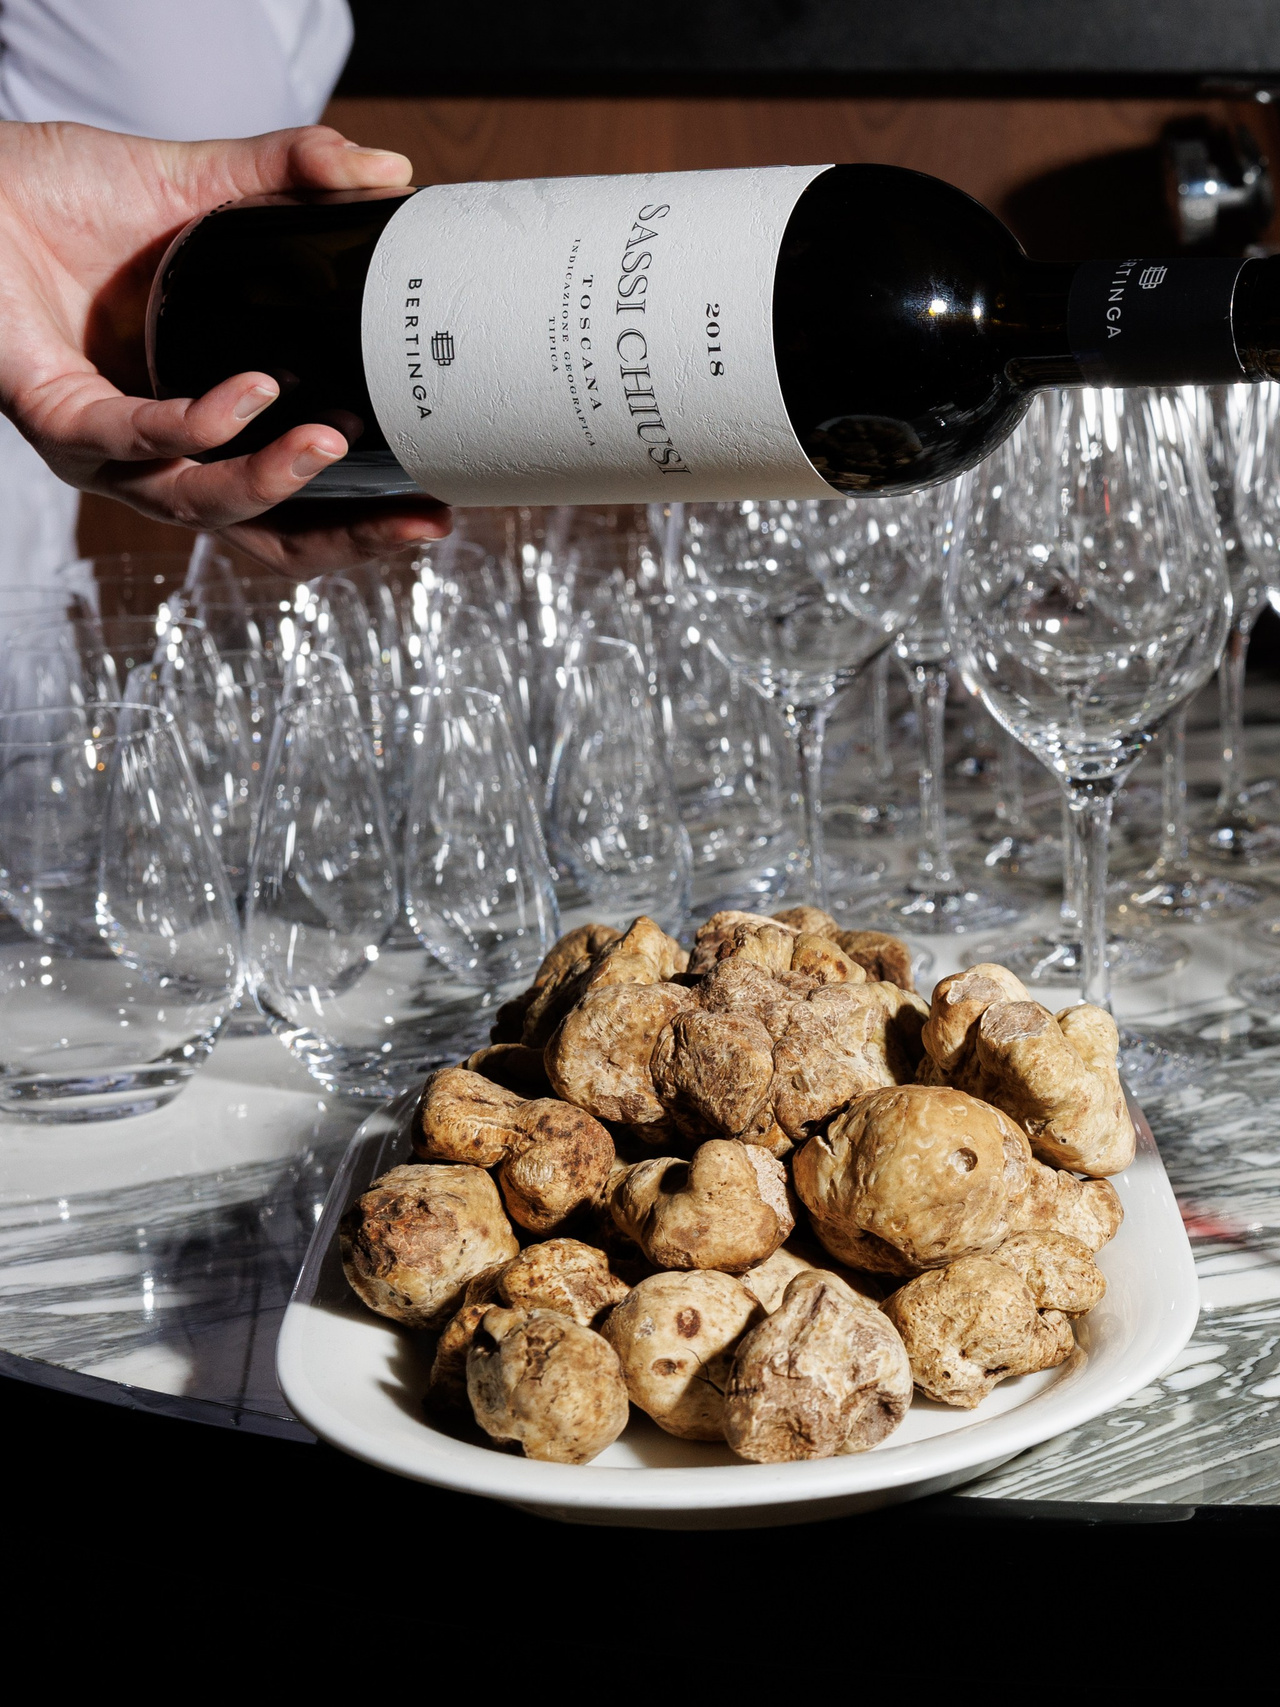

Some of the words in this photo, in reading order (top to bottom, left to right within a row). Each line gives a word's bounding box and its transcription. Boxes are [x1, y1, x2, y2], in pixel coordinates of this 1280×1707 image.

[562, 239, 582, 342] INDICAZIONE
[616, 203, 671, 315] SASSI
[1106, 258, 1144, 339] RTINGA
[405, 278, 432, 420] BERTINGA
[548, 316, 559, 374] TIPICA
[581, 275, 602, 411] TOSCANA
[706, 303, 724, 377] 2018
[562, 351, 596, 448] GEOGRAFICA
[616, 328, 692, 475] CHIUSI
